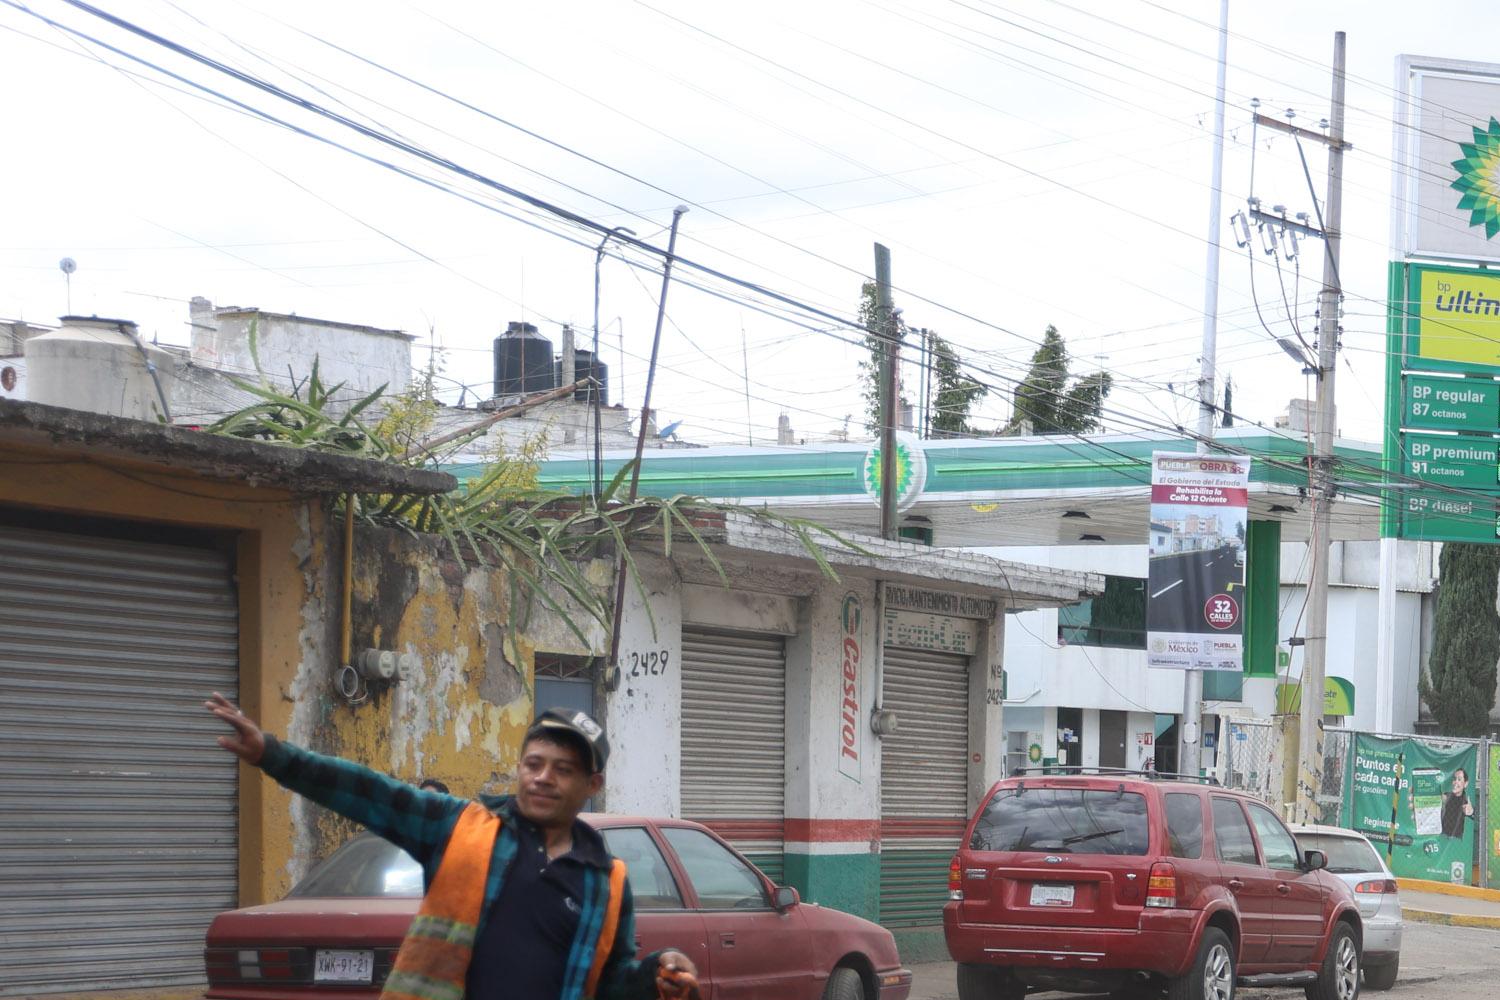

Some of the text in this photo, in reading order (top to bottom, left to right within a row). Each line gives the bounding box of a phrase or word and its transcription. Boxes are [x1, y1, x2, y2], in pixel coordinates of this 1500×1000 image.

[1437, 280, 1451, 294] bp
[1412, 385, 1486, 404] BP regular
[1412, 402, 1467, 420] 87 octanos
[1411, 443, 1496, 464] BP premium
[1160, 460, 1191, 470] PUEBLA
[1199, 462, 1228, 472] OBRA
[1411, 461, 1465, 477] 91 octanos
[1175, 487, 1213, 495] Rehabilita
[1170, 494, 1189, 502] Calle
[1199, 495, 1228, 504] Oriente
[1214, 600, 1231, 613] 32
[1168, 645, 1198, 654] México
[631, 650, 669, 677] 2429
[842, 637, 860, 761] Castrol
[1355, 756, 1406, 774] Puntos en
[1354, 772, 1379, 784] cada
[1362, 786, 1388, 796] gasolina
